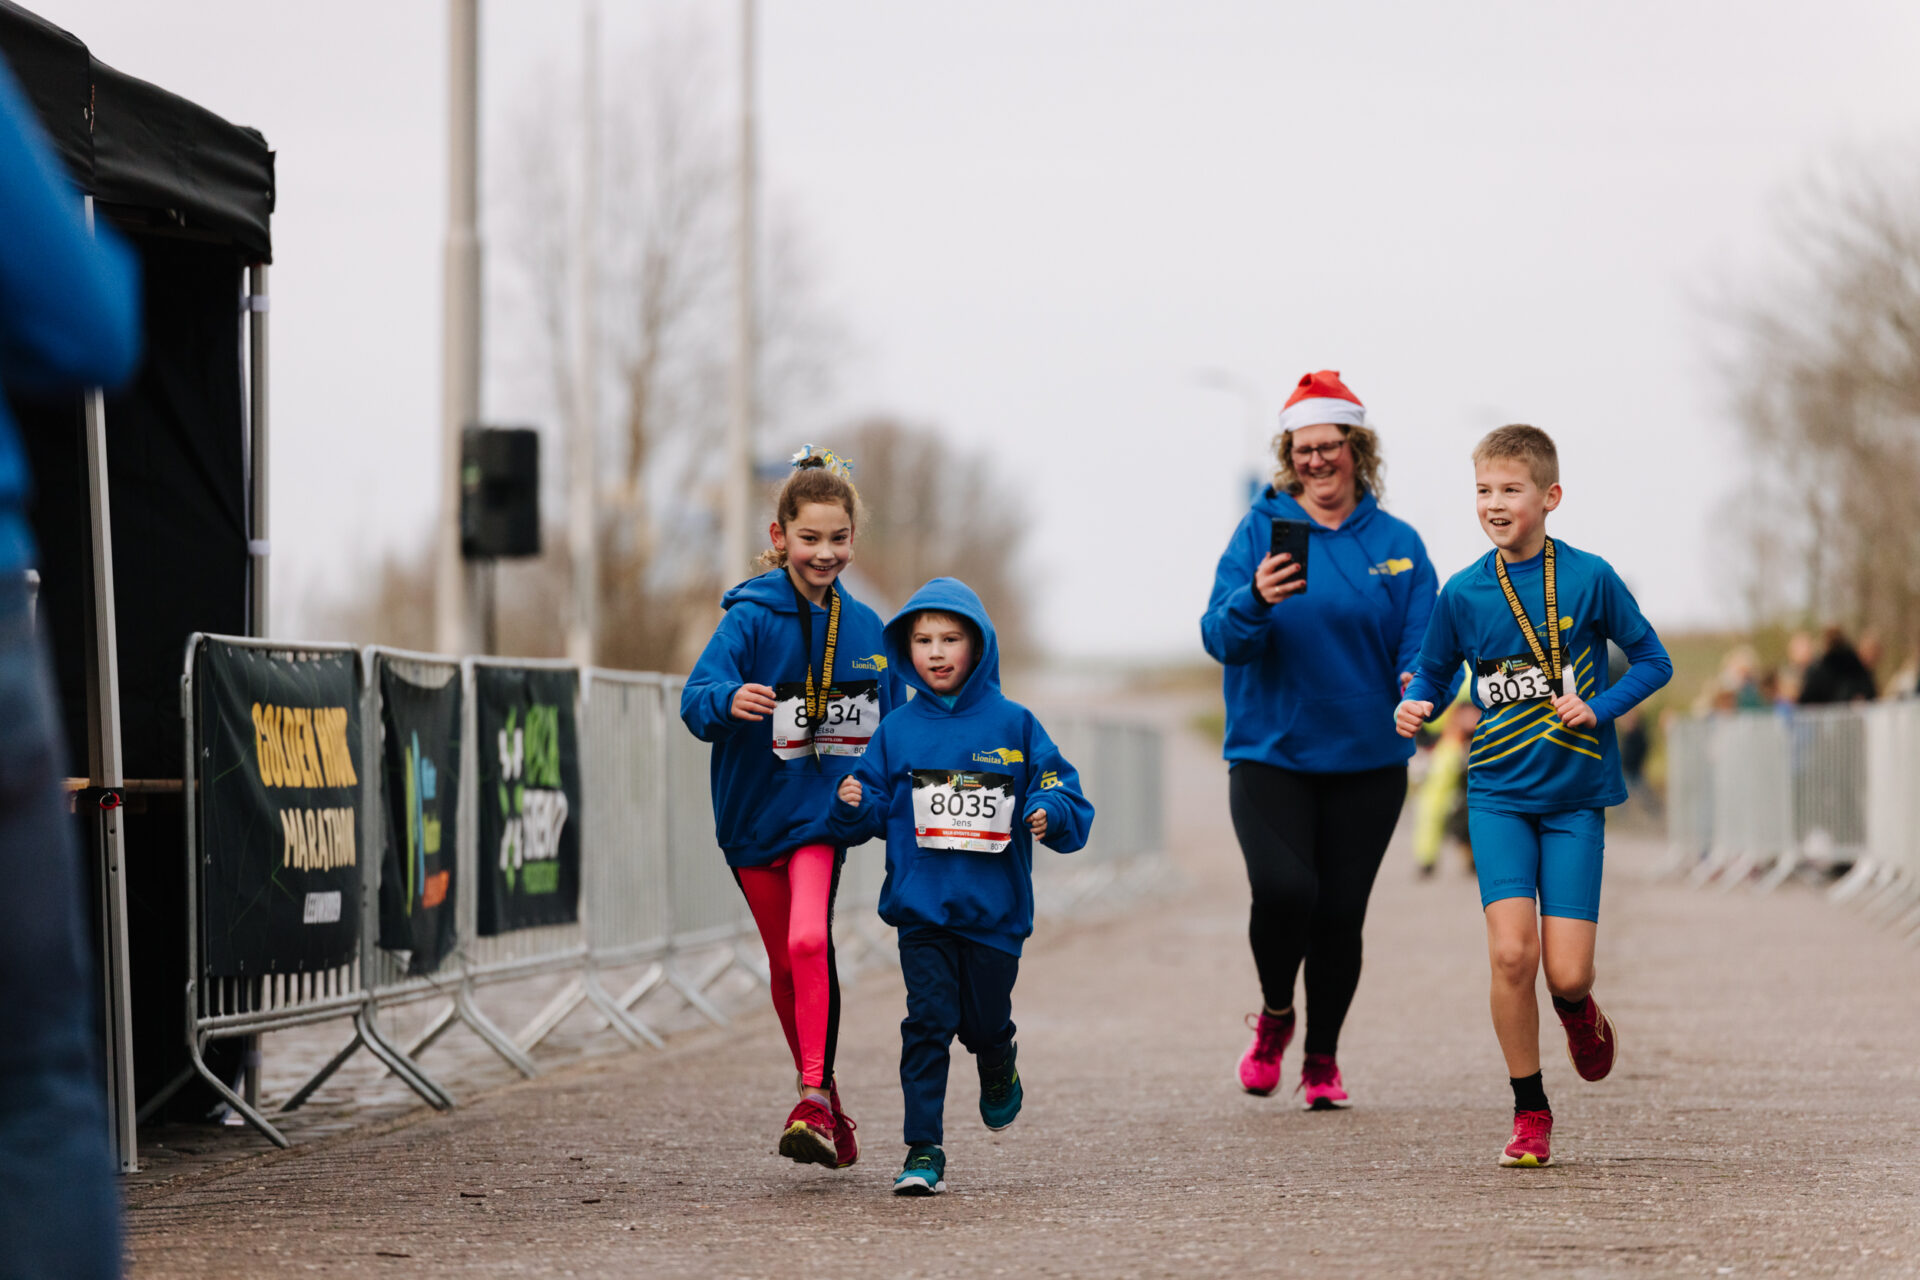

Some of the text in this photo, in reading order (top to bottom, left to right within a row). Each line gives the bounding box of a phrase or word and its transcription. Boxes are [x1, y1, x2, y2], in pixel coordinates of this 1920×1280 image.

[827, 597, 841, 646] LEEUWARDEN
[1500, 575, 1524, 617] MARATHON
[1517, 614, 1546, 662] LEEUWARDEN
[1539, 660, 1553, 680] 2024
[1544, 540, 1562, 679] WINTER MARATHON LEEUWARDEN 2024
[822, 646, 835, 689] MARATHON
[1488, 673, 1553, 703] 8033
[817, 689, 828, 719] WINTER
[252, 702, 324, 788] GOLDEN
[972, 753, 1002, 764] Lionitas
[930, 793, 997, 818] 8035
[951, 818, 972, 827] Jens
[280, 807, 356, 872] MARATHON
